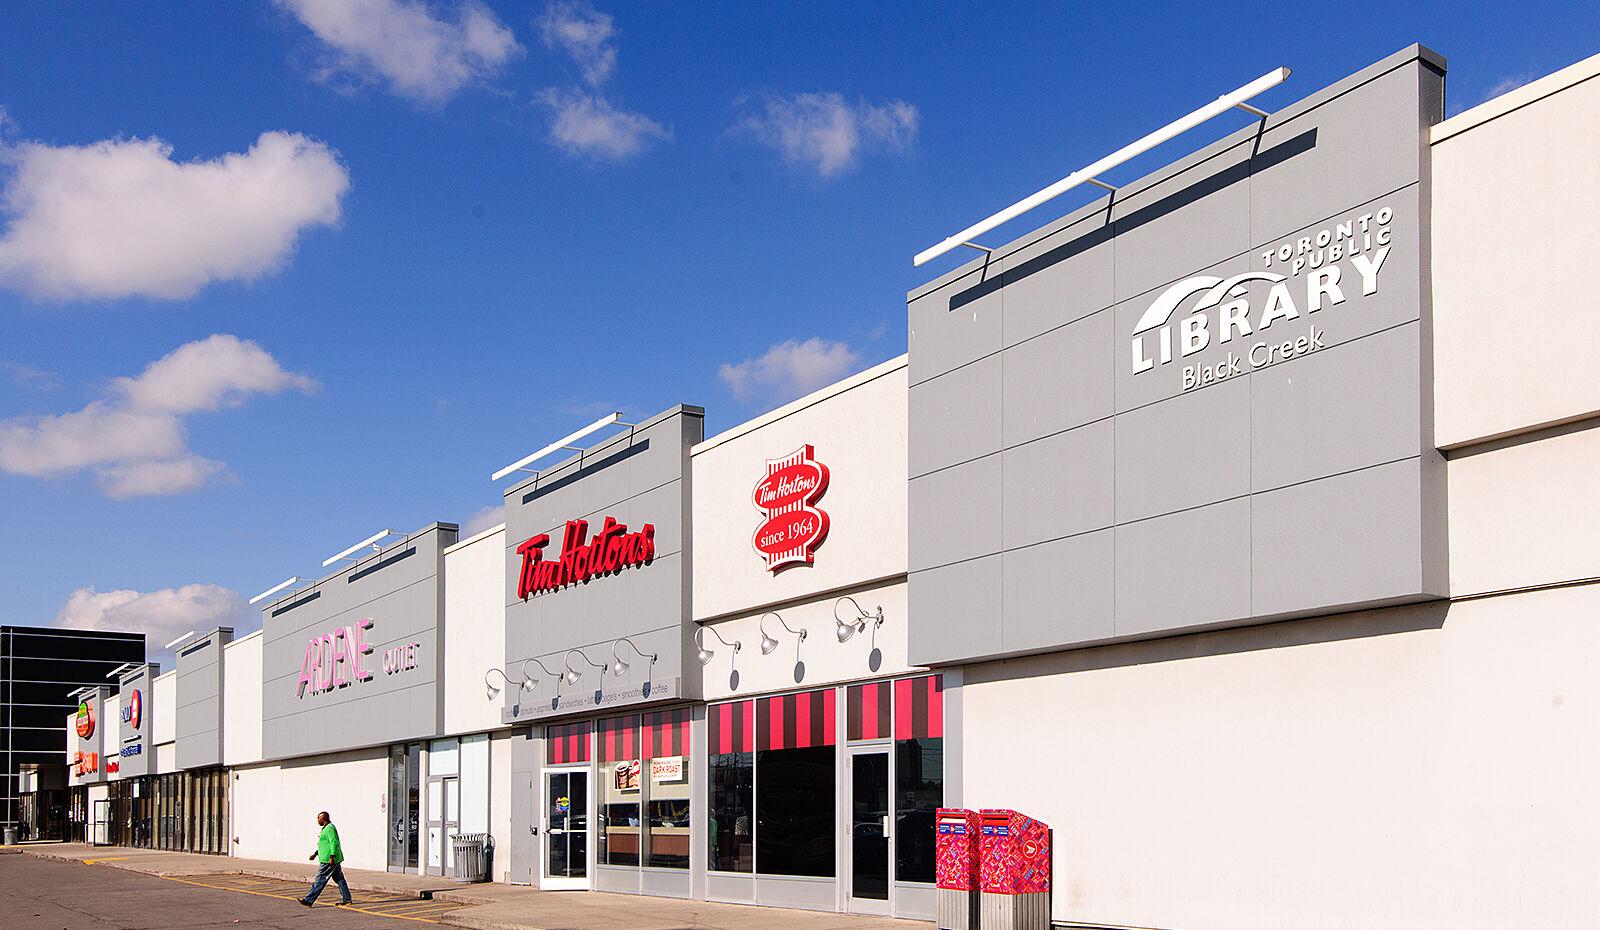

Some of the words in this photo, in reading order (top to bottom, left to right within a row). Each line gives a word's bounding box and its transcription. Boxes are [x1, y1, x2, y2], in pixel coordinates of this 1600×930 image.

[1261, 206, 1394, 268] TORONTO
[1291, 226, 1392, 276] PUBLIC
[1131, 246, 1392, 376] LIBRARY
[1181, 352, 1241, 391] Black
[1248, 325, 1325, 368] Creek
[759, 481, 777, 505] Tim
[776, 474, 816, 499] Hortons
[516, 533, 560, 601] Tim
[558, 516, 656, 587] Hortons
[760, 531, 785, 548] since
[787, 516, 814, 540] 1964
[295, 617, 374, 698] ARDENE
